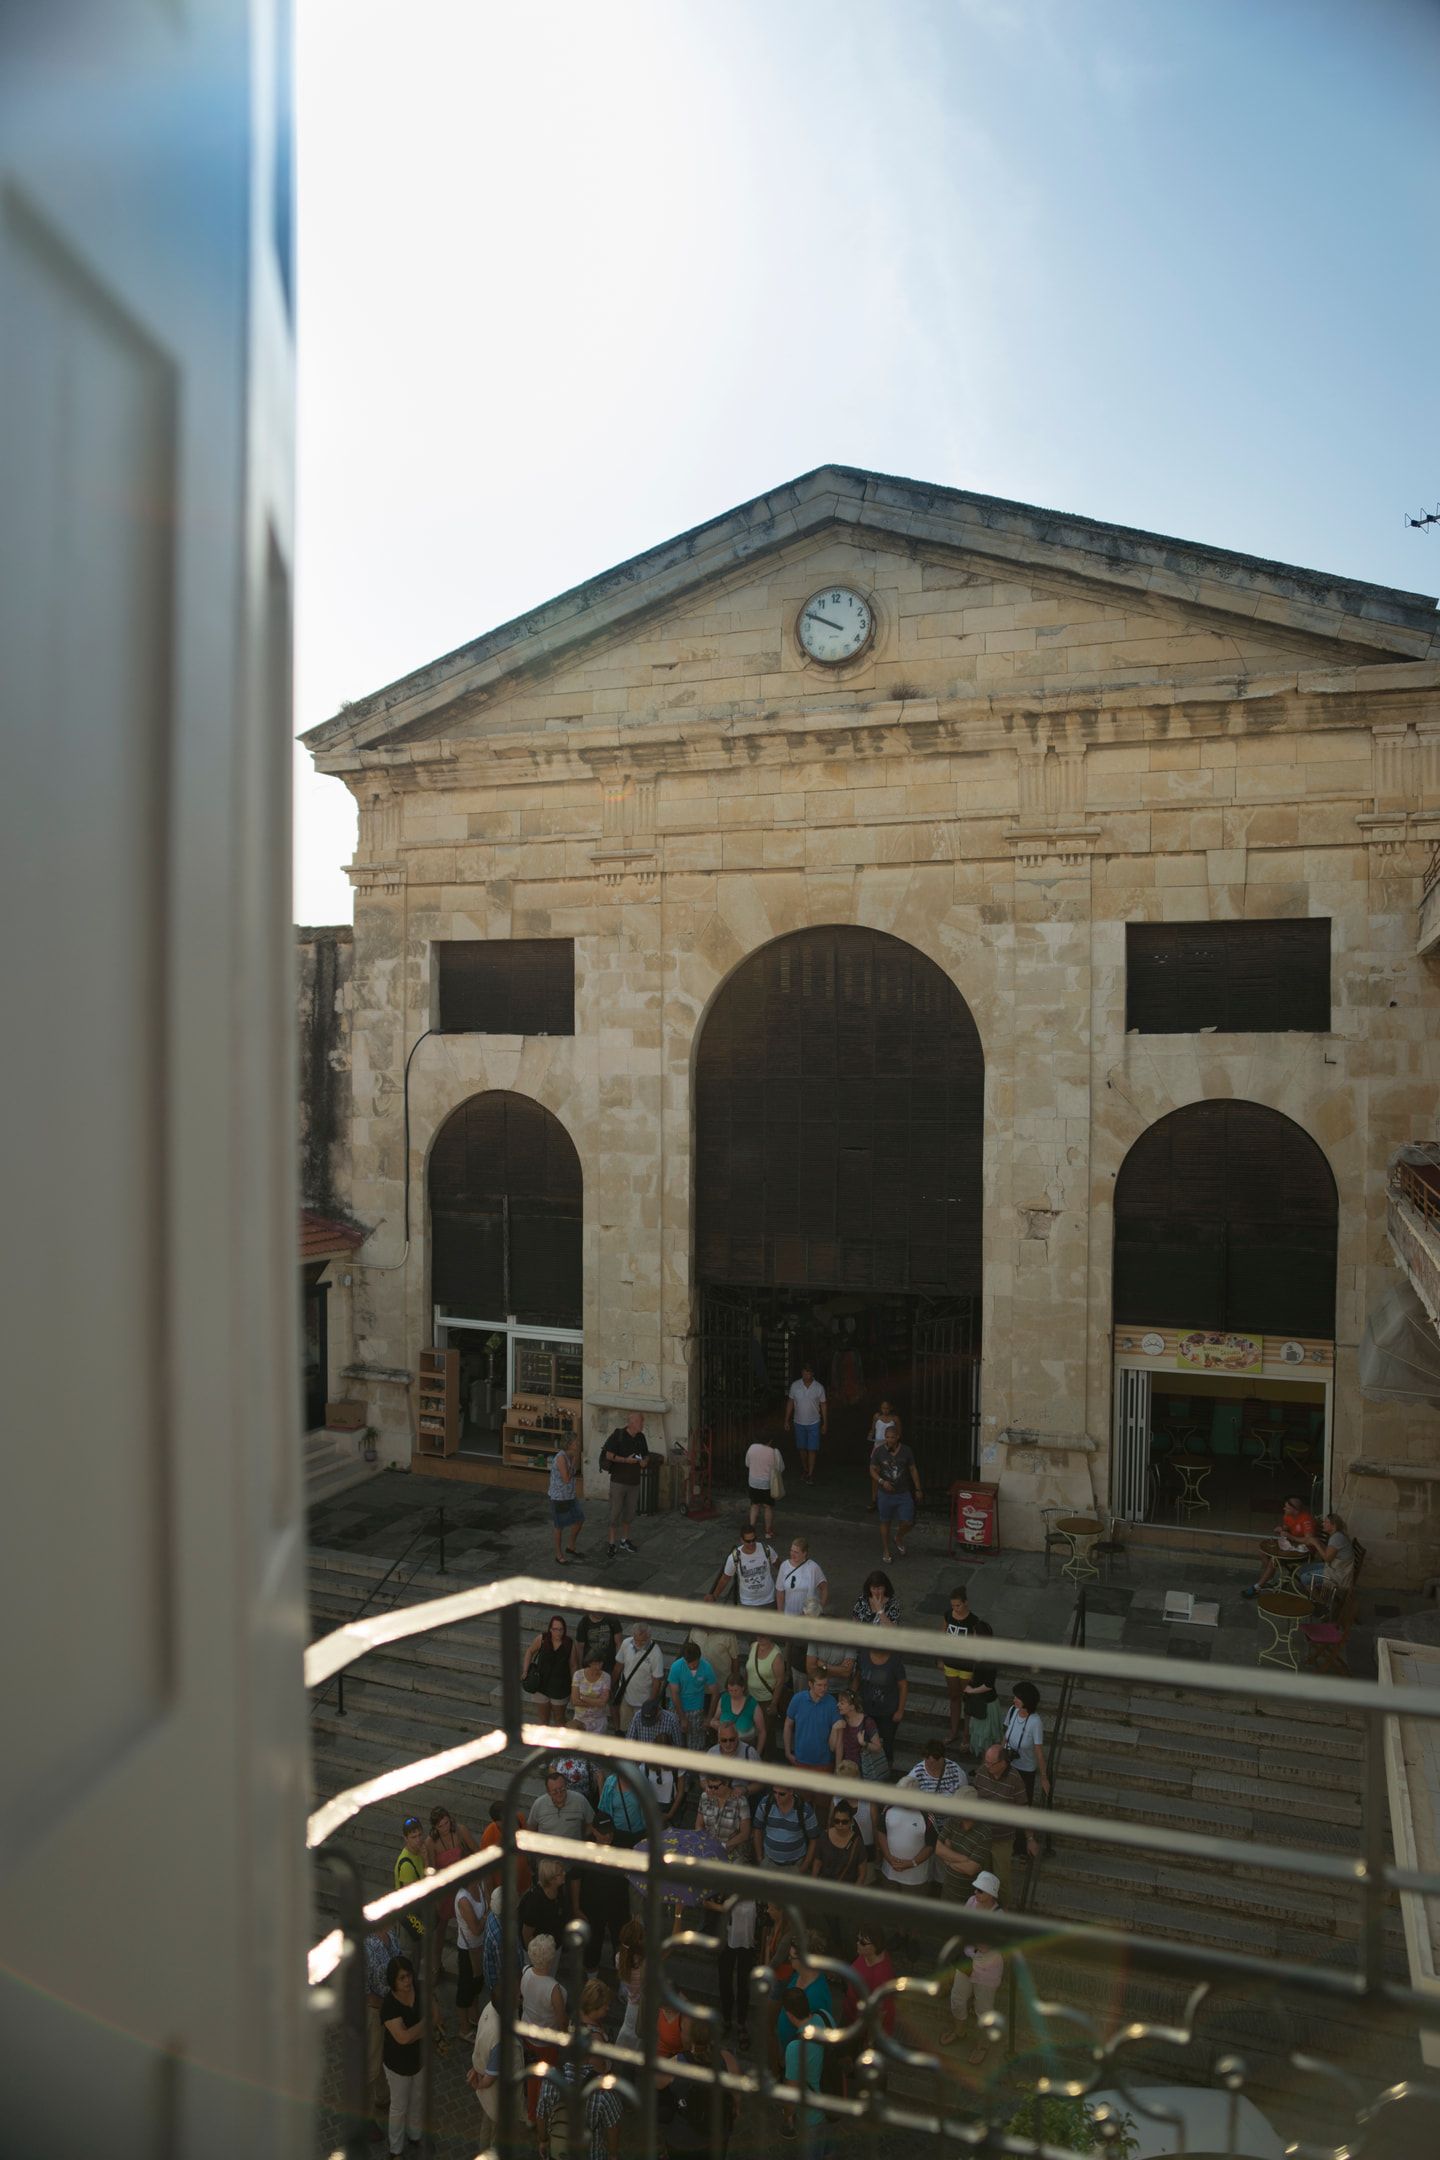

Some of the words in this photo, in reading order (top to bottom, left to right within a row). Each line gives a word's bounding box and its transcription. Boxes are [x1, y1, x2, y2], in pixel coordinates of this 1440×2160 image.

[831, 594, 841, 603] 12
[848, 597, 852, 607] 1
[817, 599, 825, 609] 11
[857, 607, 863, 617] 2
[859, 619, 866, 629] 3
[854, 634, 860, 643] 4
